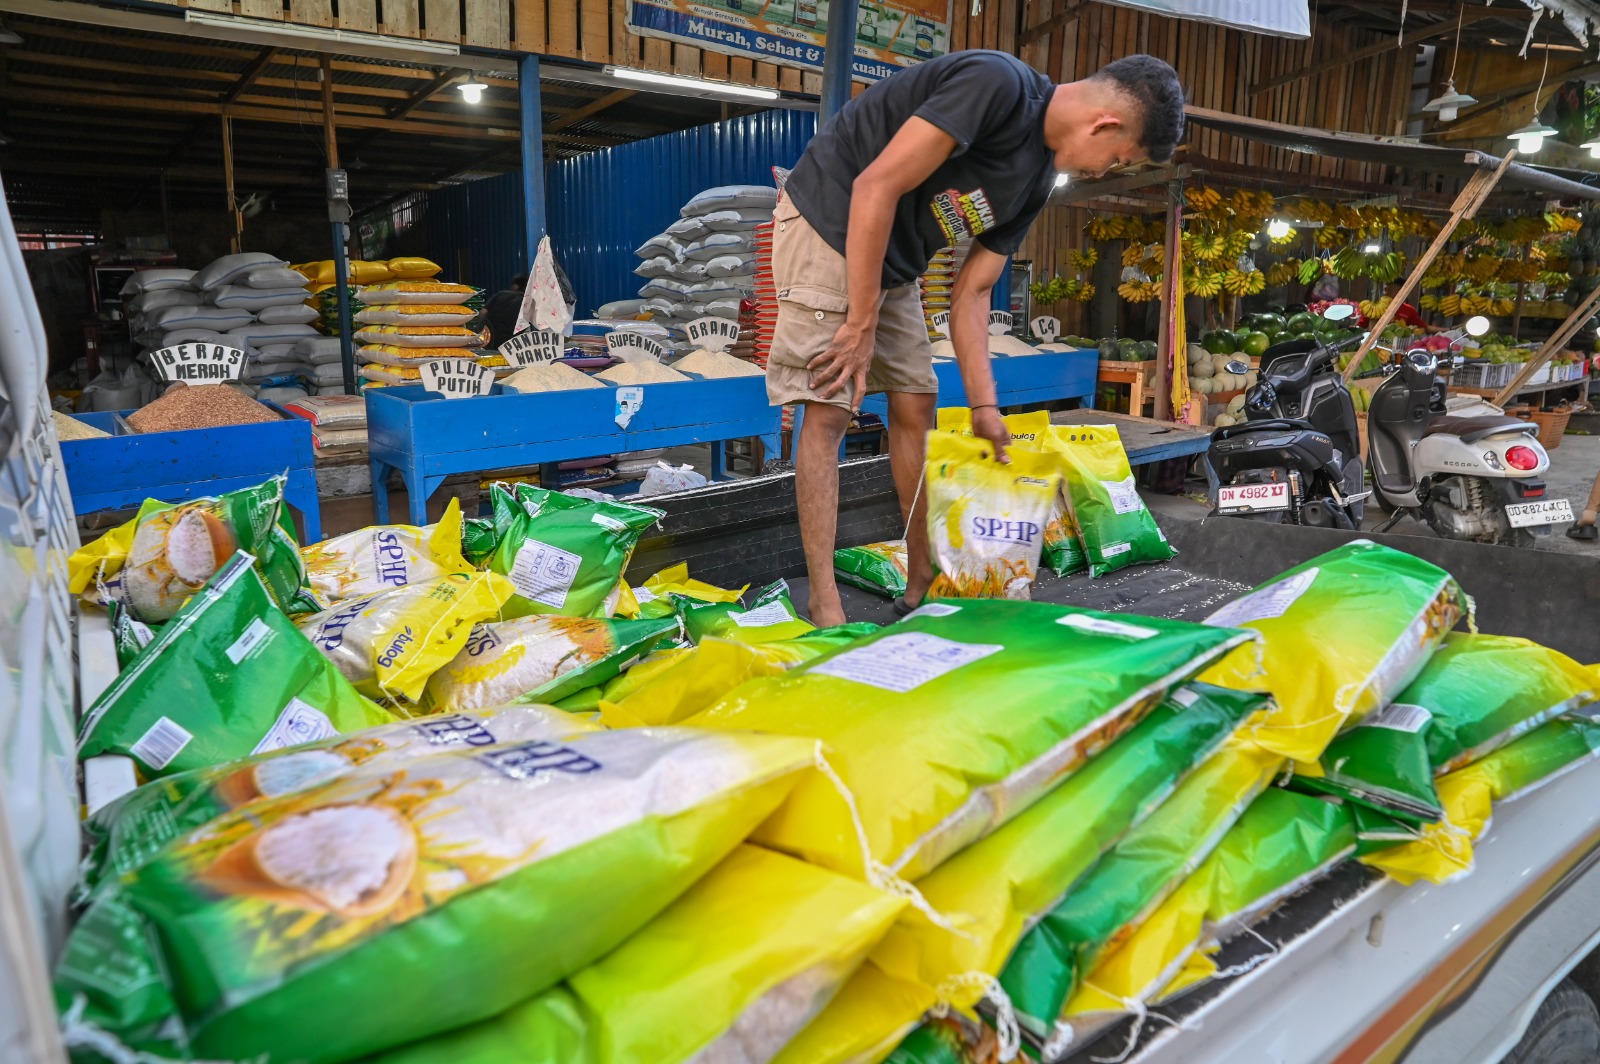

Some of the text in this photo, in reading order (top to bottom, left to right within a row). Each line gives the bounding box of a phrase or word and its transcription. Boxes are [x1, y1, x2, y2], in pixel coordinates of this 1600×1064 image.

[714, 11, 734, 23] Goreng
[687, 20, 751, 49] Murah,
[755, 36, 803, 58] Sehat
[805, 48, 820, 61] &
[776, 26, 795, 37] Daging
[934, 312, 950, 326] CINT
[1038, 318, 1055, 335] C4
[503, 331, 560, 356] PANDAN
[160, 343, 241, 365] BERAS
[516, 346, 557, 365] WANGI
[175, 363, 230, 379] MERAH
[430, 360, 488, 380] PULUT
[437, 376, 482, 395] PUTIH
[1010, 433, 1036, 441] bulog
[1221, 490, 1235, 501] DN
[1239, 486, 1268, 499] 4982
[972, 516, 1039, 543] SPHP
[378, 530, 408, 587] SPHP
[317, 599, 374, 652] PHP
[377, 631, 414, 668] bulog
